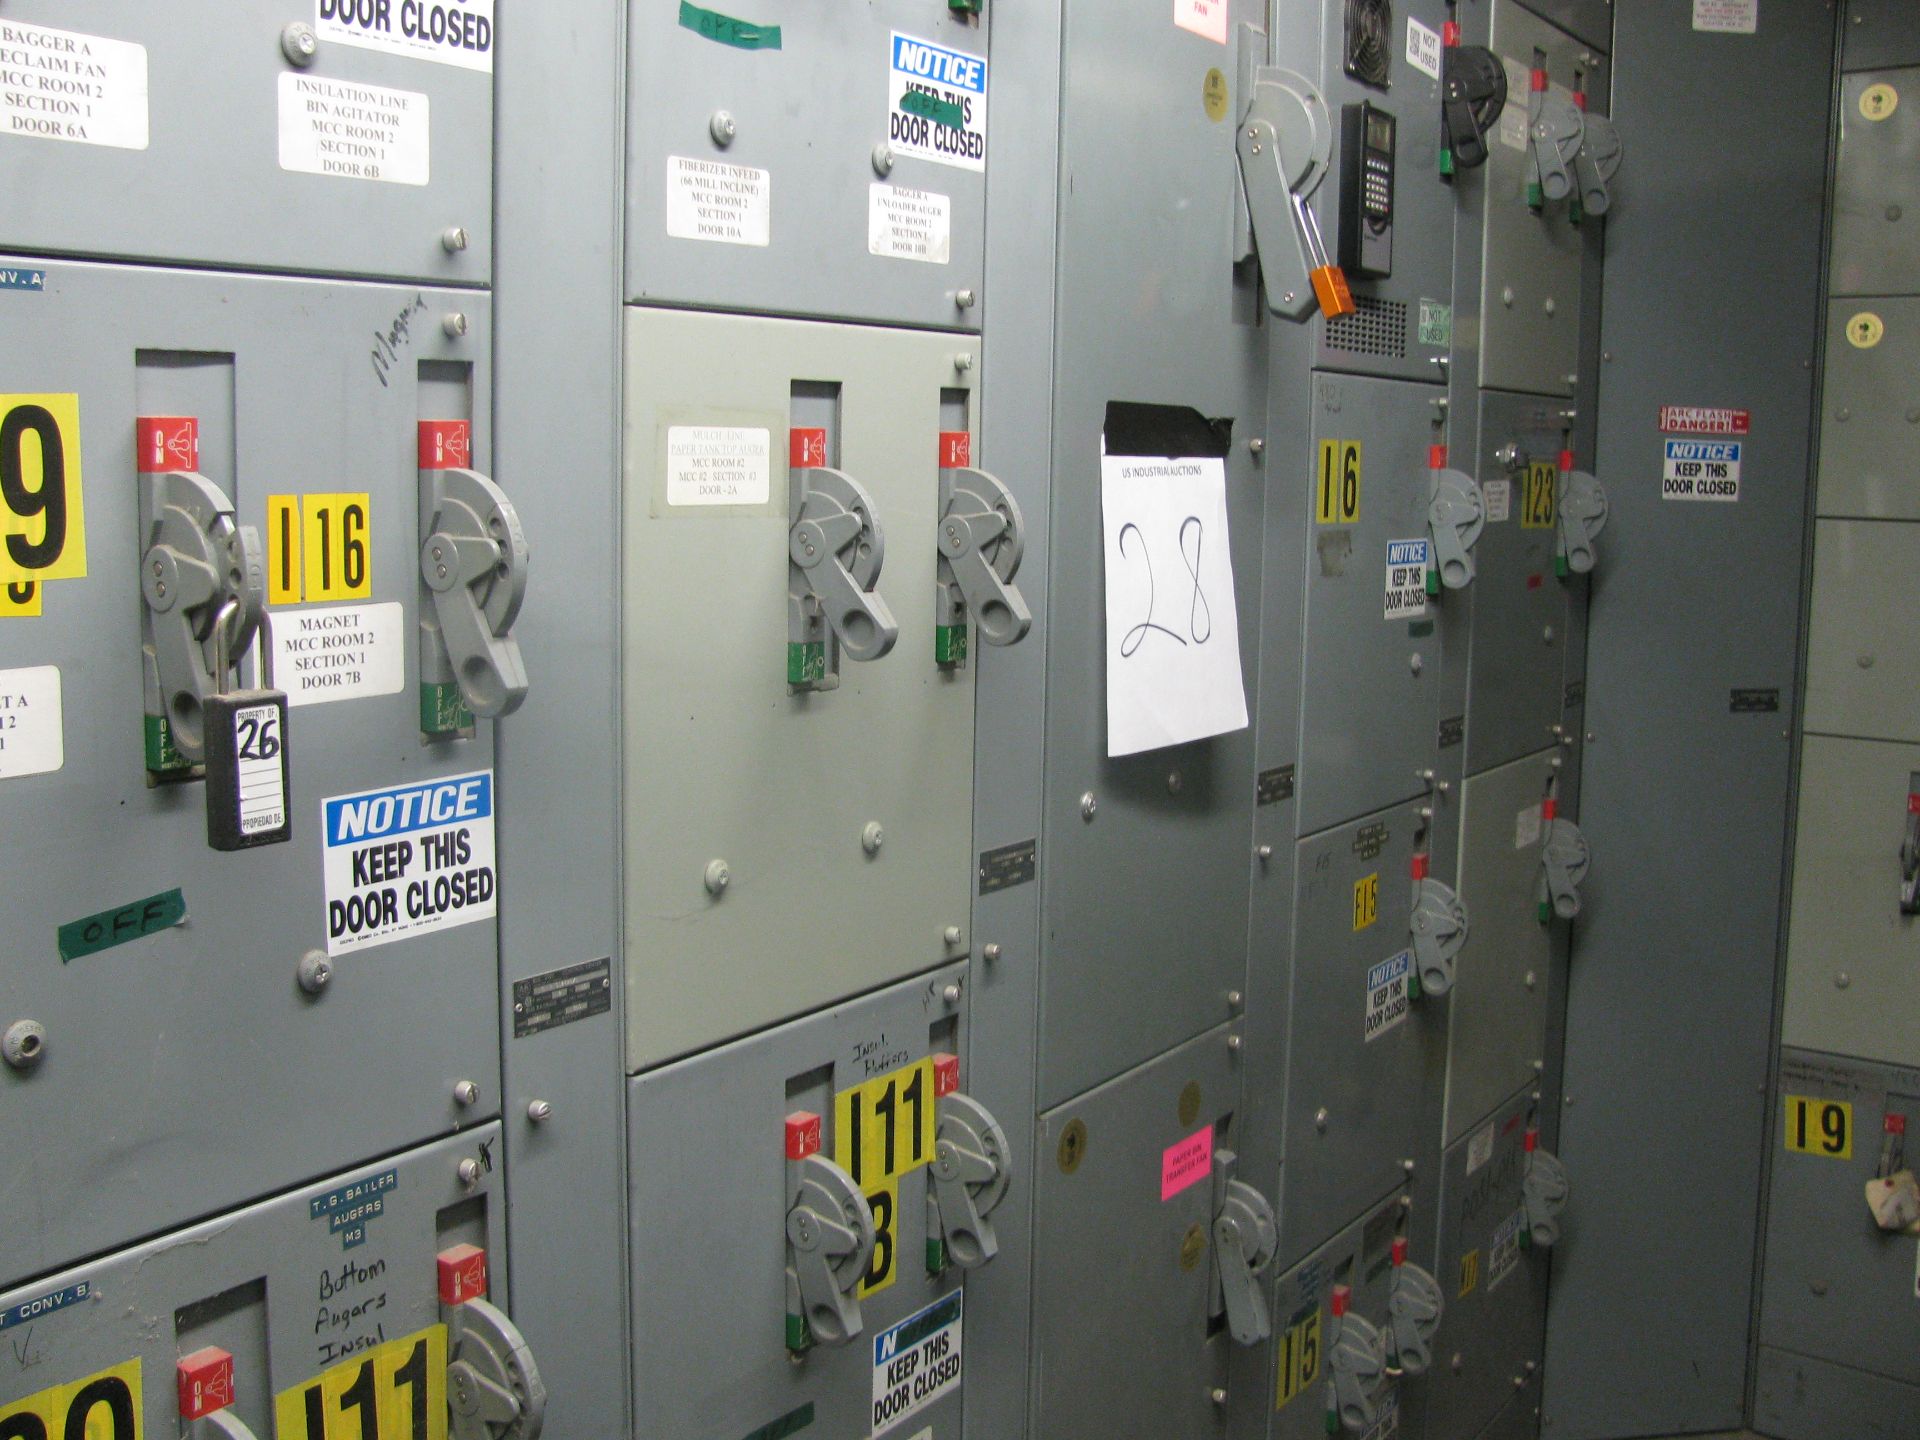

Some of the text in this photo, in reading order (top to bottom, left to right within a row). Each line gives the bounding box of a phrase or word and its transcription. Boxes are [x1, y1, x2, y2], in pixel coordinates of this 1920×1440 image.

[401, 0, 491, 52] CLOSED
[2, 26, 92, 56] BAGGER A
[1423, 32, 1436, 51] NOT
[74, 61, 106, 78] FAN
[897, 40, 981, 90] NOTICE
[1420, 50, 1437, 71] USED
[38, 75, 91, 97] ROOM
[95, 85, 104, 99] 2
[296, 79, 410, 111] INSULATION LINE
[5, 91, 92, 118] SECTION 1
[306, 99, 400, 127] BIN AGITATOR
[12, 115, 88, 140] DOOR 6A
[311, 118, 395, 145] MCC ROOM 2
[890, 111, 929, 148] DOOR
[934, 121, 984, 160] CLOSED
[320, 139, 386, 161] SECTION 1
[323, 158, 380, 179] DOOR 6B
[679, 159, 761, 181] FIBERIZER INFEED
[680, 175, 760, 197] (66 MILL INCLINE)
[892, 185, 928, 202] BAGGER A
[691, 191, 749, 210] MCC ROOM 2
[877, 195, 942, 217] UNLOADER AUGER
[697, 206, 736, 222] SECTION
[888, 212, 903, 223] MCC
[905, 216, 927, 229] ROOM
[697, 223, 742, 239] DOOR 10A
[892, 226, 923, 240] SECTION
[892, 241, 927, 255] DOOR 10B
[1669, 419, 1730, 432] DANGER!
[1670, 442, 1735, 461] NOTICE
[692, 457, 711, 468] MCC
[711, 457, 735, 468] ROOM
[1122, 465, 1202, 479] US INDUSTRIAL AUCTIONS
[1675, 462, 1728, 478] KEEP THIS
[0, 404, 67, 570] 9
[678, 471, 696, 482] MCC
[712, 471, 746, 482] SECTION
[1663, 479, 1737, 495] DOOR CLOSED
[699, 484, 738, 496] DOOR 2A
[1389, 543, 1426, 563] NOTICE
[1119, 515, 1211, 659] 28
[1391, 567, 1421, 588] KEEP THIS
[1385, 589, 1425, 610] DOOR CLOSED
[300, 613, 361, 631] MAGNET
[285, 631, 375, 653] MCC ROOM 2
[295, 651, 366, 671] SECTION 1
[301, 671, 362, 690] DOOR 7B
[17, 693, 28, 707] A
[8, 715, 17, 729] 2
[238, 719, 280, 760] 26
[338, 780, 482, 841] NOTICE
[242, 815, 273, 829] PROPIEDAD
[352, 828, 472, 888] KEEP THIS
[329, 887, 399, 938] DOOR
[406, 866, 494, 919] CLOSED
[83, 900, 167, 944] OFF
[1371, 952, 1407, 989] NOTICE
[1373, 978, 1402, 1009] KEEP THIS
[1366, 996, 1407, 1034] DOOR CLOSED
[345, 1229, 363, 1244] M3
[319, 1258, 386, 1301] Bottom
[887, 1331, 950, 1389] KEEP THIS
[873, 1384, 911, 1427] DOOR
[913, 1352, 960, 1401] CLOSED
